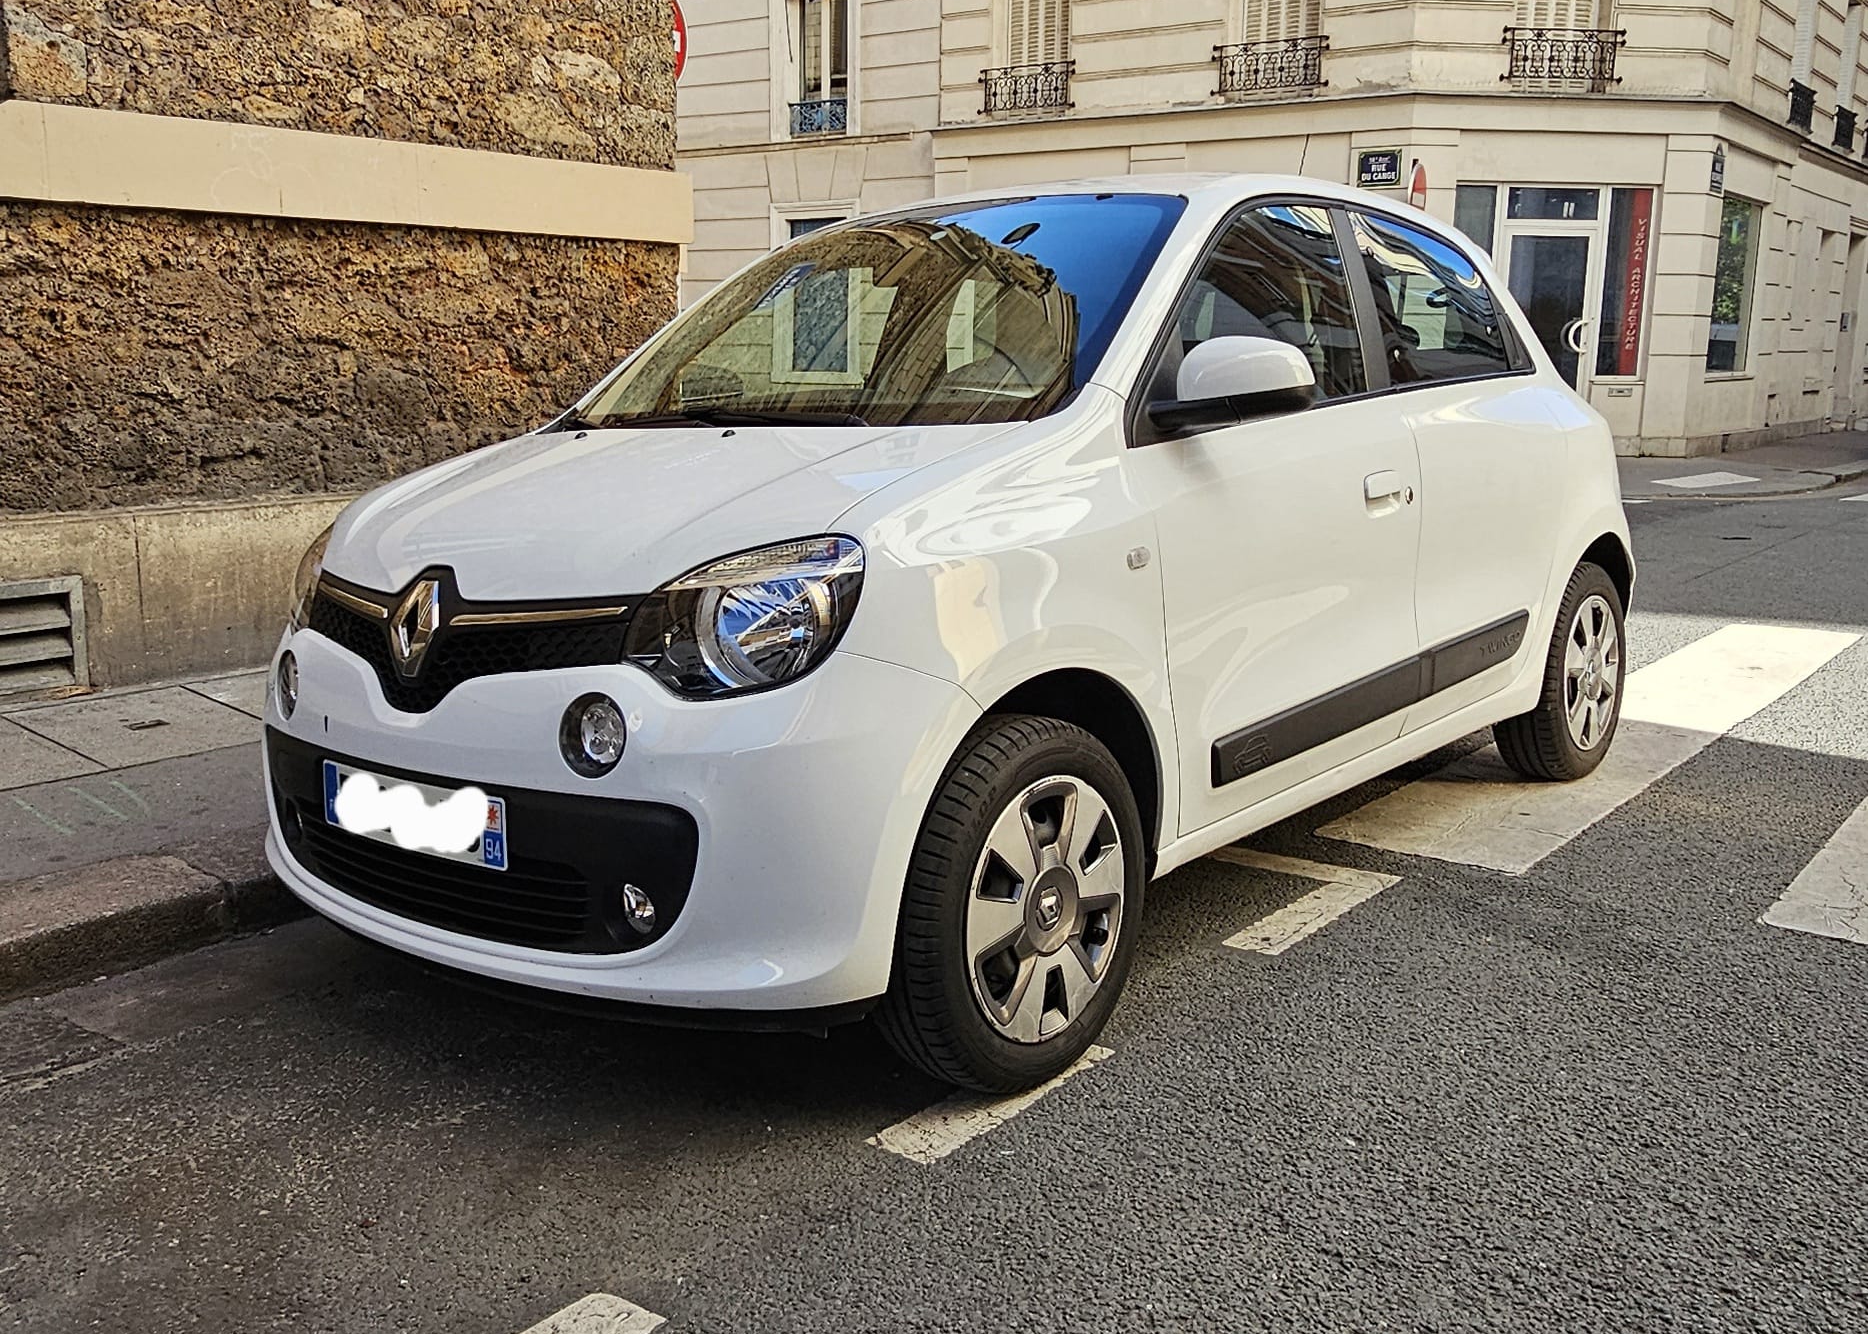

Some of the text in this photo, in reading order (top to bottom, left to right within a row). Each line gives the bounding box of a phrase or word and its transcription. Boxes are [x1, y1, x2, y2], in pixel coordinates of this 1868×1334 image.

[1371, 164, 1387, 172] RUE
[1361, 173, 1372, 181] DU
[1624, 218, 1648, 351] VISUAL ARCHITECTURE
[485, 838, 502, 862] 94
